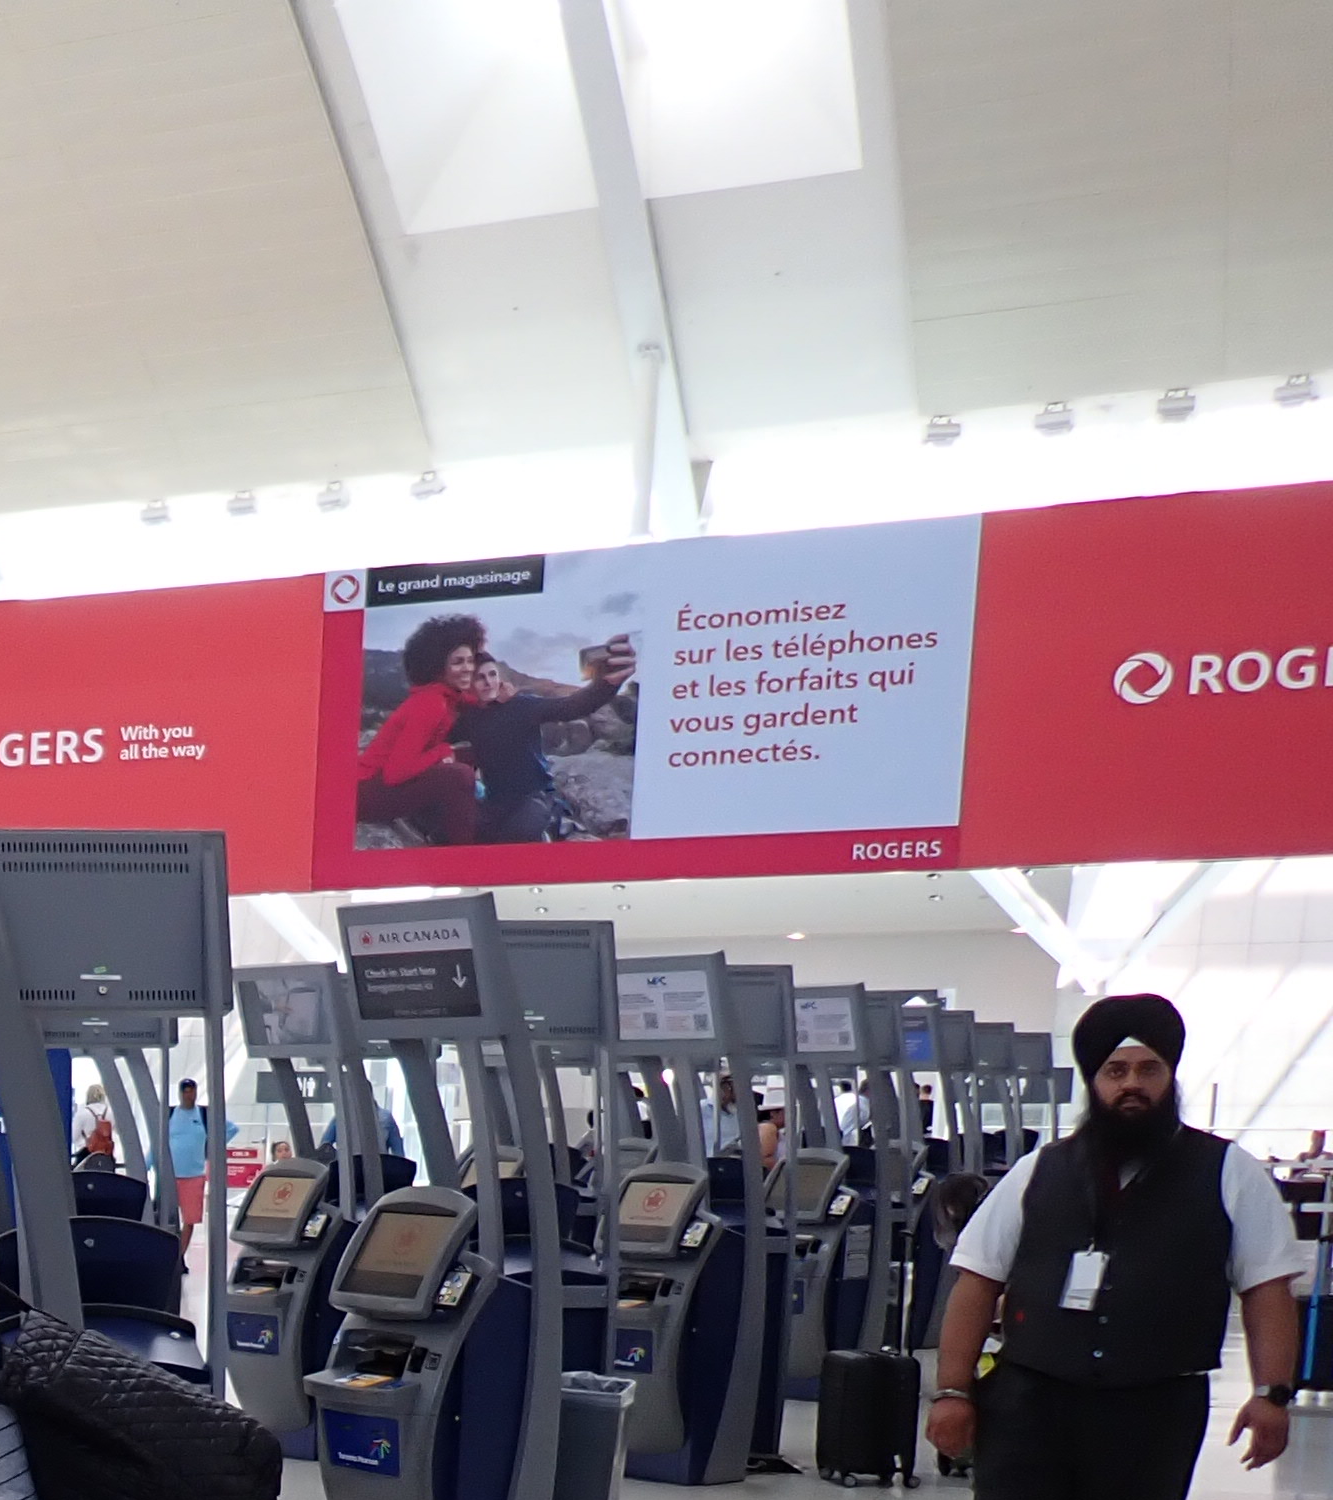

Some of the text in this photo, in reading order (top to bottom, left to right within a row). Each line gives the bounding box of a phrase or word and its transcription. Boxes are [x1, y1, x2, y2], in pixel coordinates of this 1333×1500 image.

[377, 568, 531, 596] Le grand magasinage
[677, 602, 846, 632] Économisez
[673, 627, 939, 668] sur les téléphones
[672, 661, 914, 700] et les forfaits qui
[1188, 645, 1333, 696] ROG
[670, 701, 859, 737] vous gardent
[120, 724, 194, 746] With you
[119, 743, 206, 762] all the way
[668, 738, 821, 768] connectés.
[852, 839, 943, 861] ROGERS
[378, 928, 460, 944] AIR CANADA
